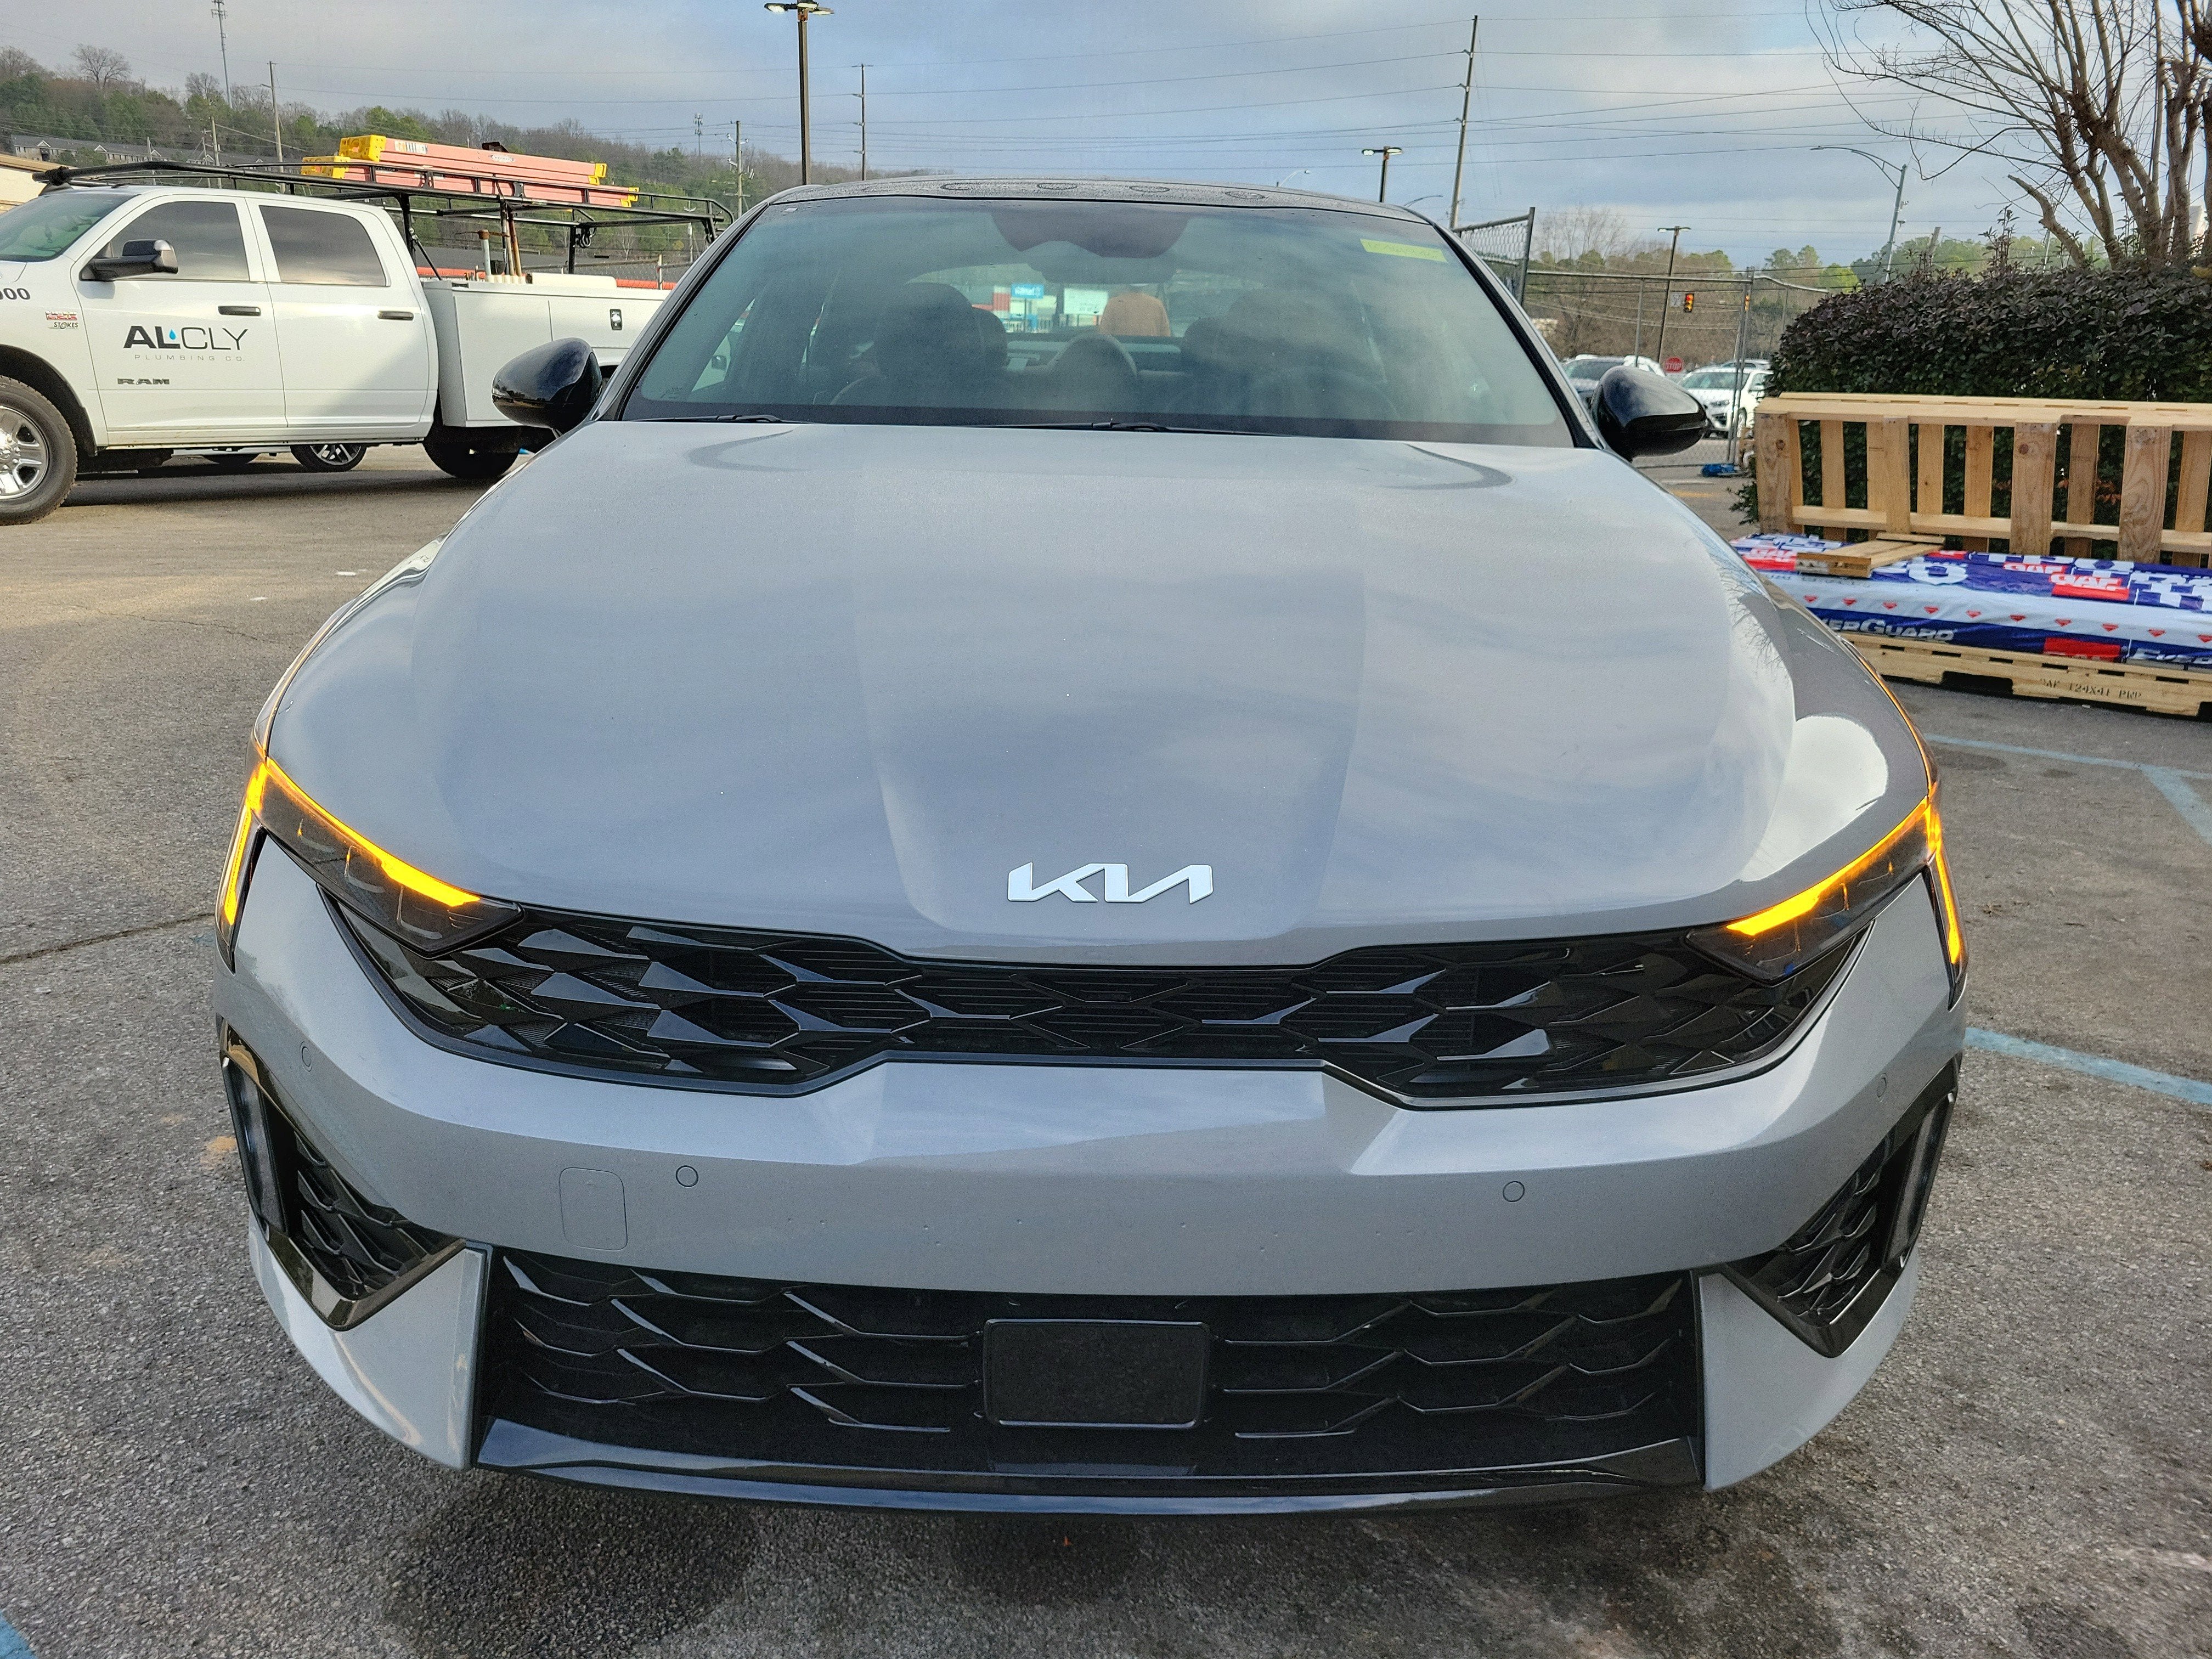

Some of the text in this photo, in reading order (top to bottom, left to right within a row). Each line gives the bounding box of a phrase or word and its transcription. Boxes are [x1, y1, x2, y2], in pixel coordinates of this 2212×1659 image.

[0, 288, 31, 300] 00
[53, 321, 78, 330] STOKES
[123, 325, 249, 351] ALCLY
[1665, 362, 1682, 370] STOP
[2050, 573, 2121, 591] GAF
[1007, 861, 1214, 904] KIA
